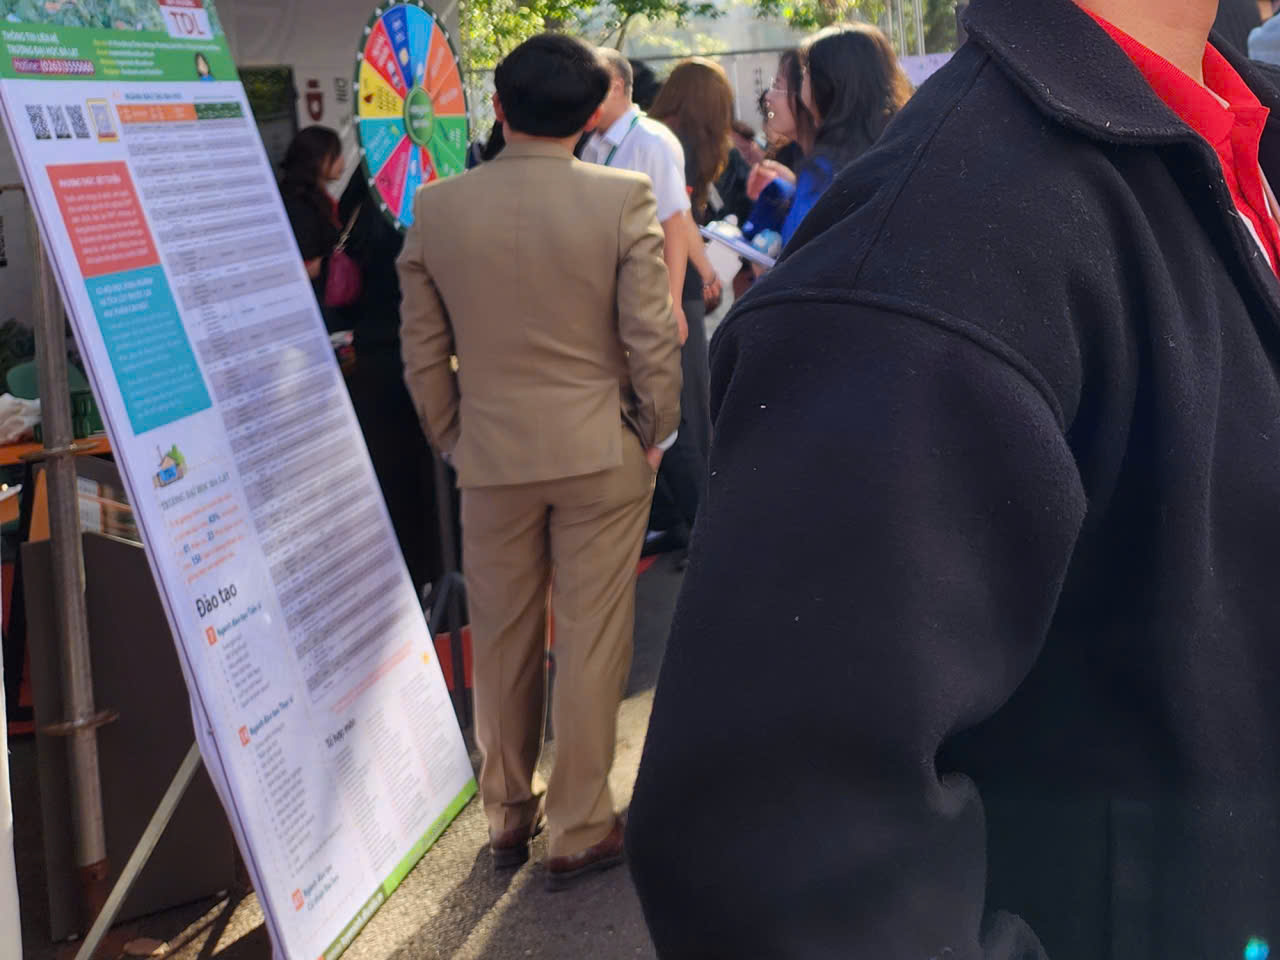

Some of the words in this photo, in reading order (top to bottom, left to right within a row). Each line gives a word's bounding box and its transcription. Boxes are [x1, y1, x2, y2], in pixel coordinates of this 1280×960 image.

[169, 11, 206, 35] TDL
[194, 592, 220, 619] Đào
[218, 582, 238, 607] tạo
